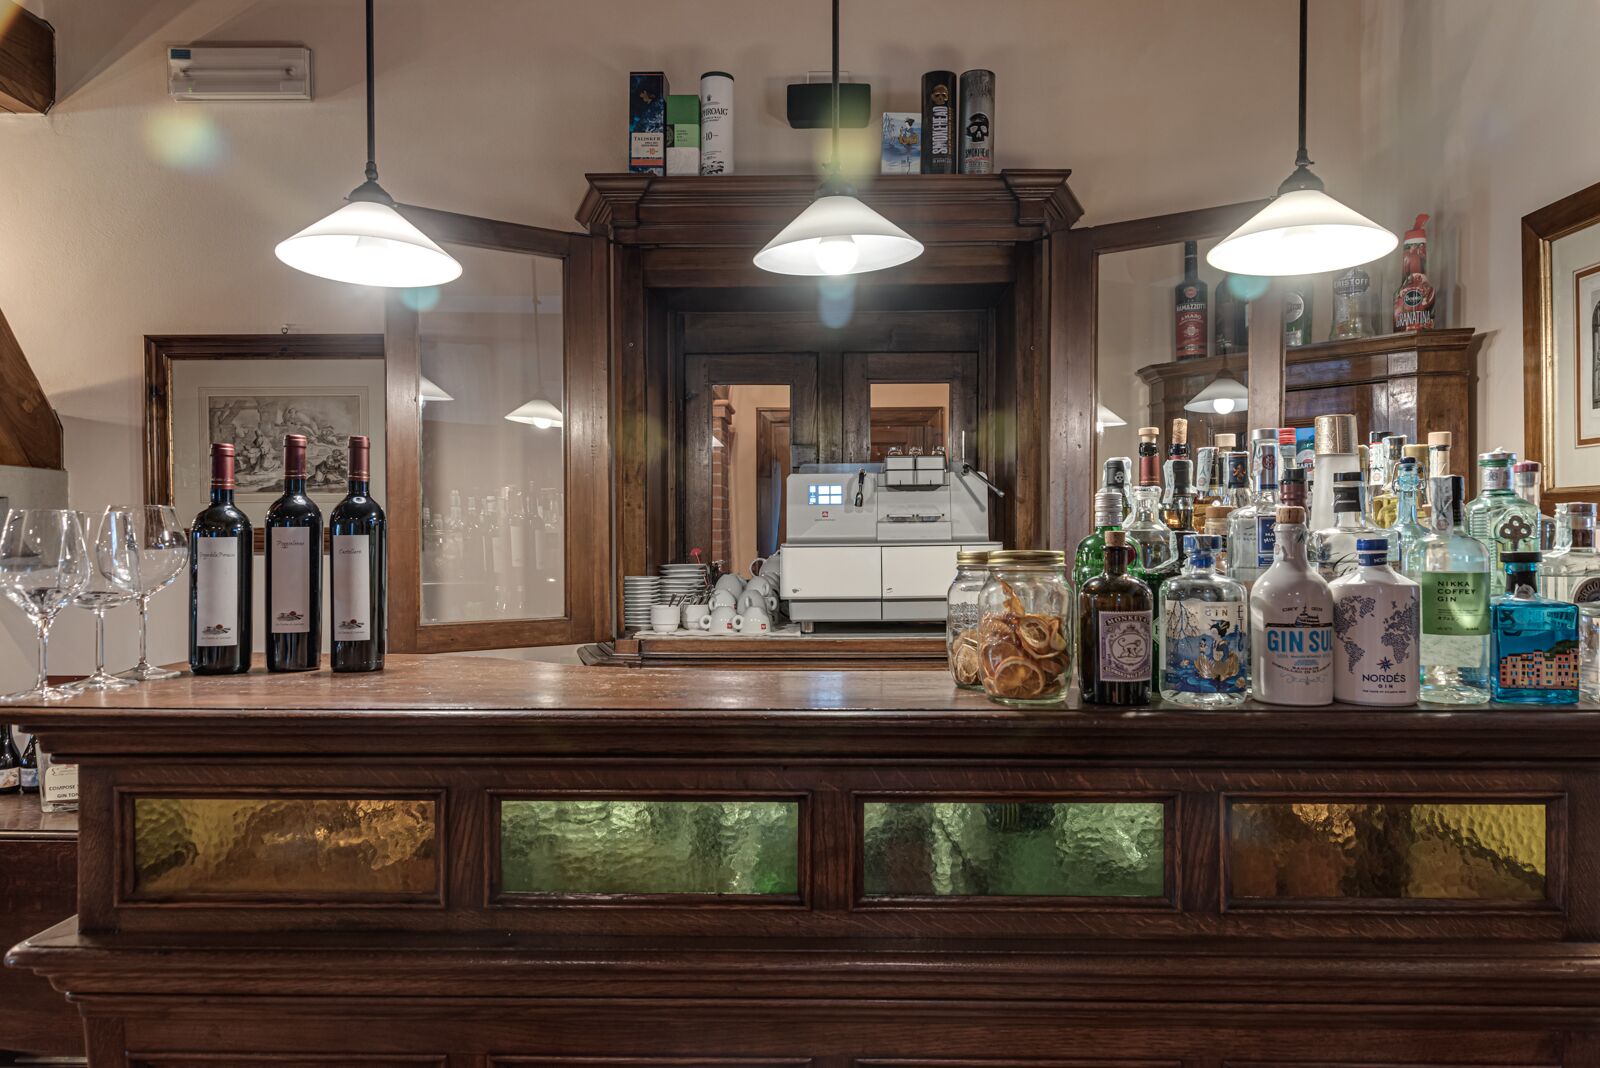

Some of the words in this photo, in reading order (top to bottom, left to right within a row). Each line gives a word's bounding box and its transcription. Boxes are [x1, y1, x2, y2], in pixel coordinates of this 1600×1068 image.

[705, 131, 713, 141] 10
[932, 106, 948, 155] SMOKEHEAD
[1395, 311, 1431, 328] GRANATINA
[1204, 609, 1229, 617] GIN
[1267, 630, 1304, 652] GIN
[1362, 672, 1407, 683] NORDÉS
